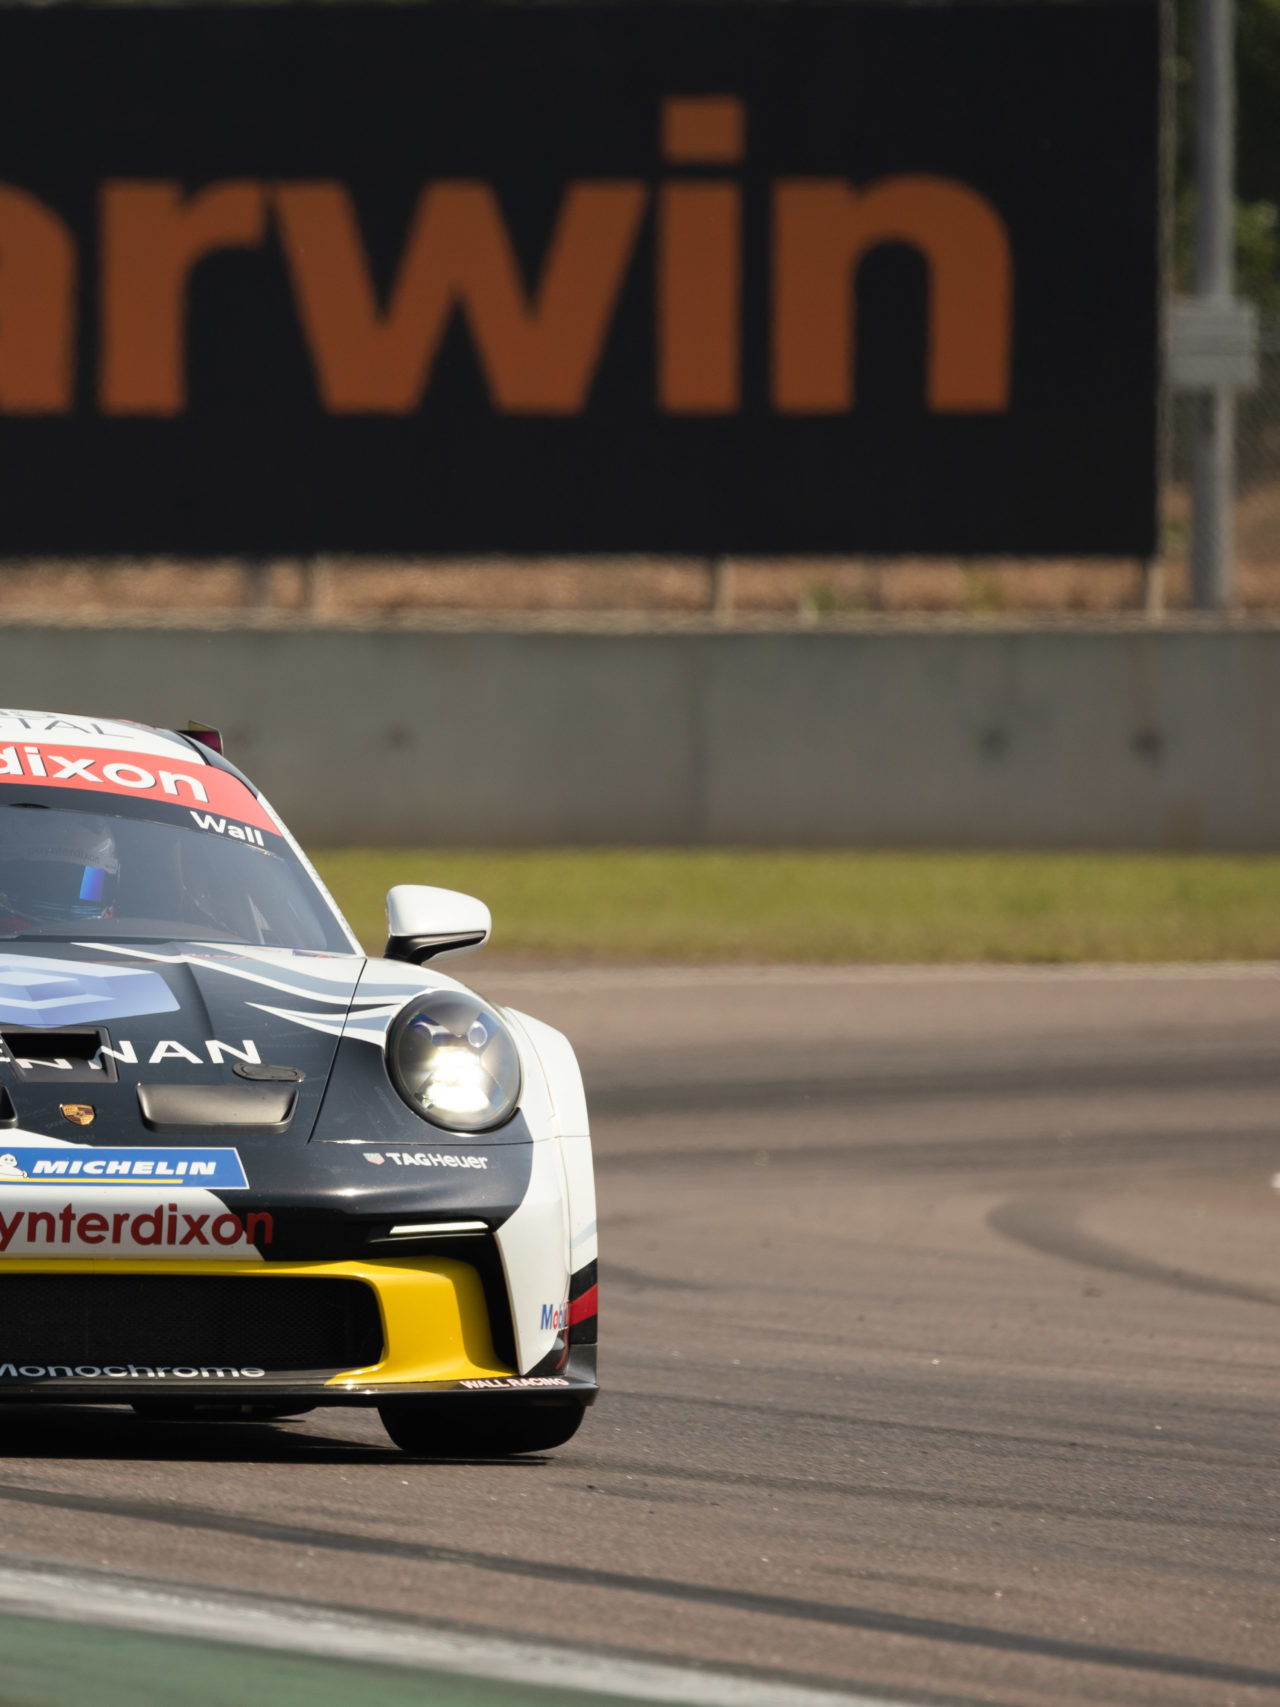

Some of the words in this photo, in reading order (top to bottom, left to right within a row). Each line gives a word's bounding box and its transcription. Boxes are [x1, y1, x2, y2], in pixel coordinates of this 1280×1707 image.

[189, 810, 265, 847] Wall
[33, 1159, 217, 1176] MICHELIN
[459, 1379, 510, 1389] WALL
[505, 1377, 570, 1387] RACING
